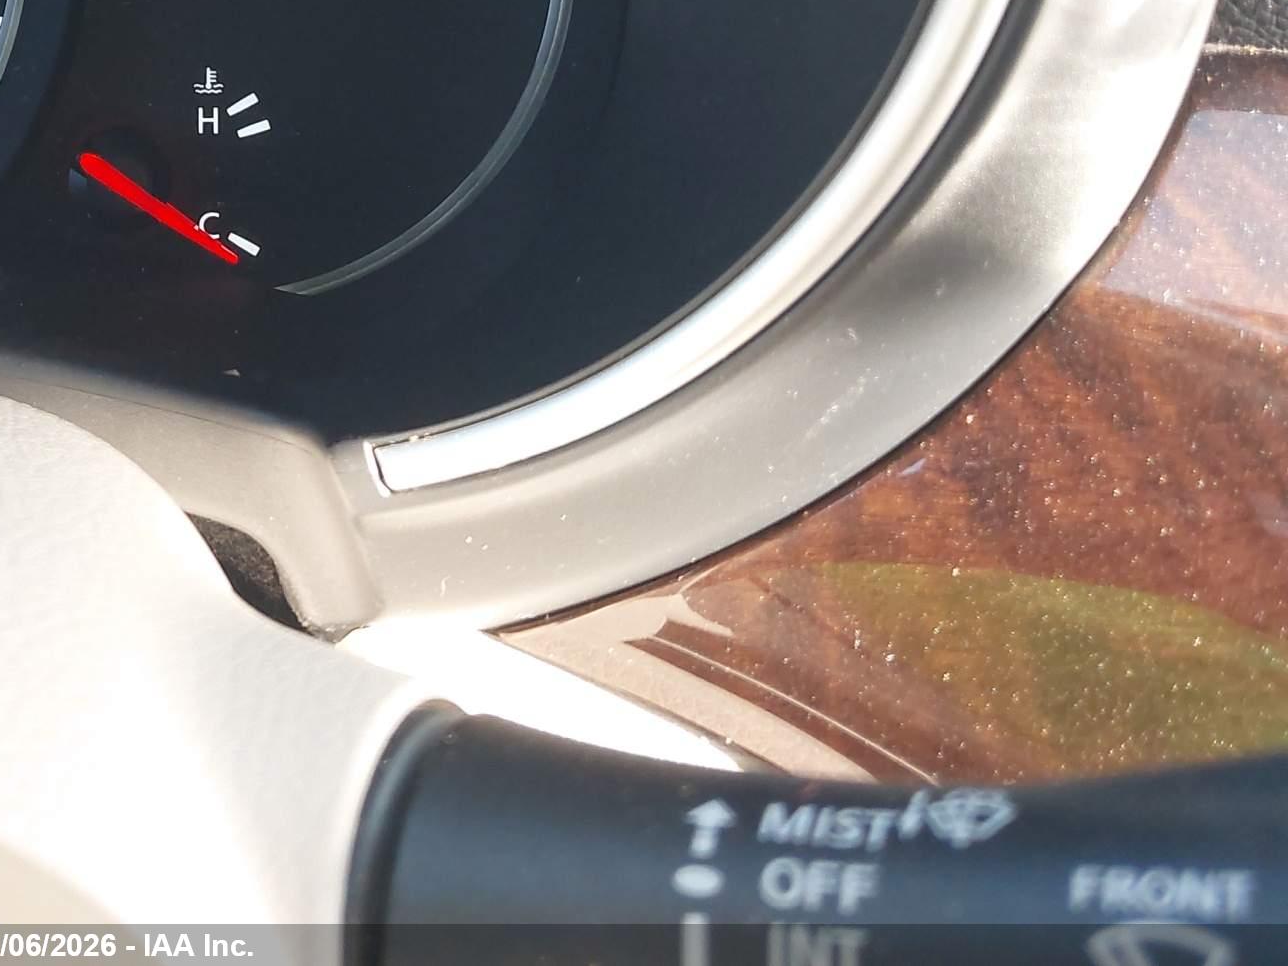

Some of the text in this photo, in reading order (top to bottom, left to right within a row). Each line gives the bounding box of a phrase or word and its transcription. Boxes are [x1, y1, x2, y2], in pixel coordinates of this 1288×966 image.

[198, 106, 219, 135] H
[199, 212, 220, 240] C
[759, 856, 878, 915] OFF
[1069, 864, 1256, 920] FRONT
[768, 921, 867, 966] INT
